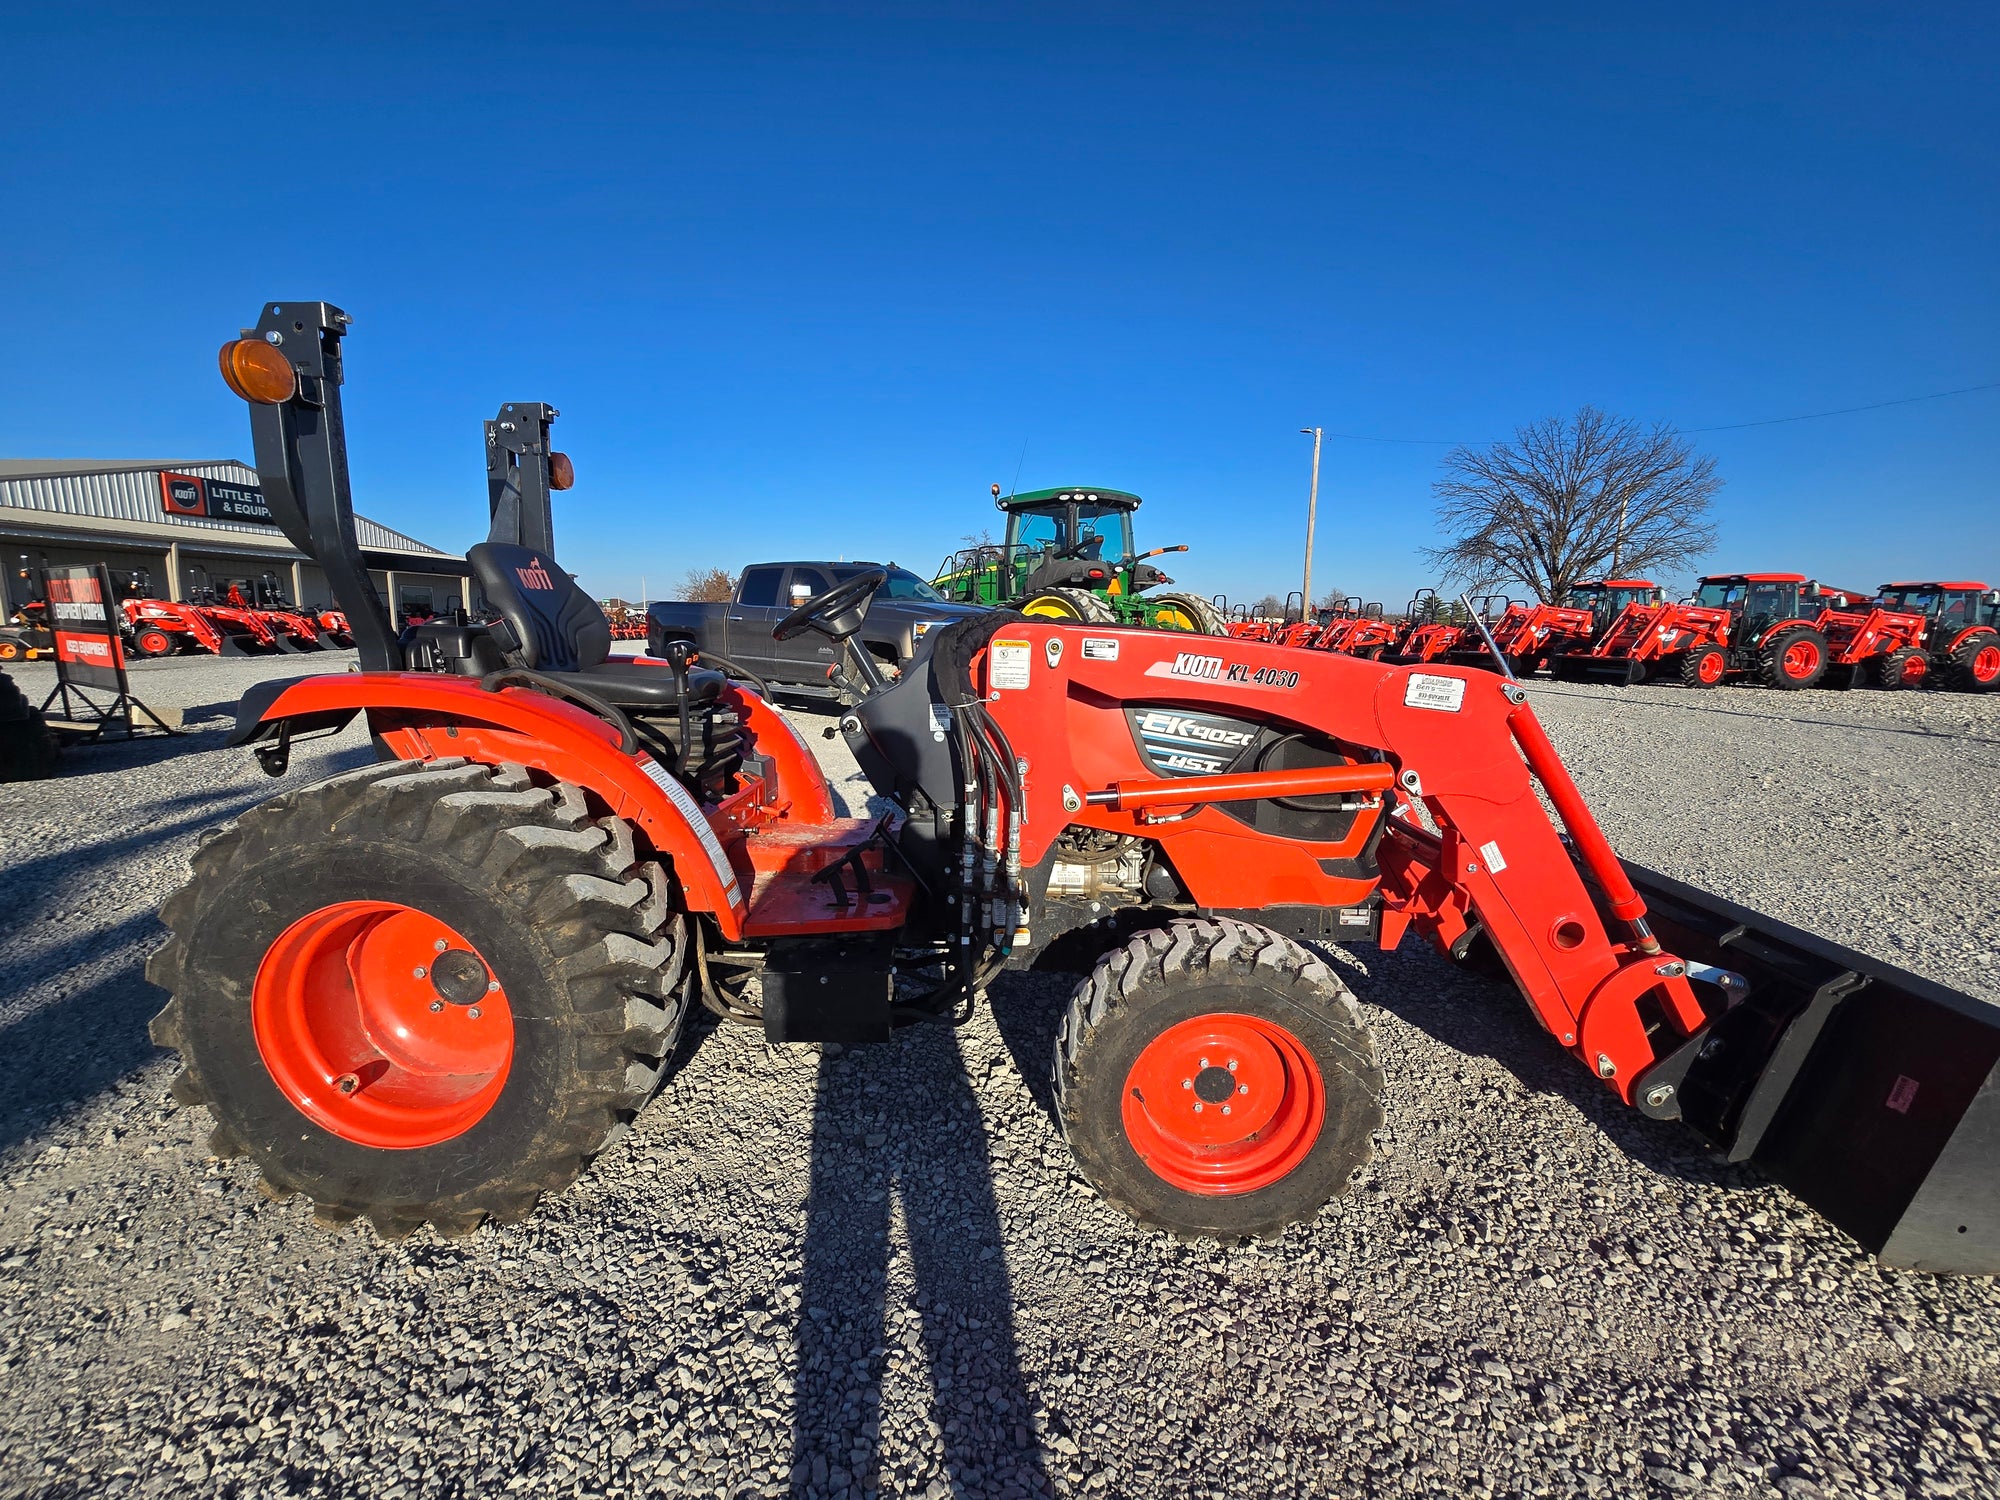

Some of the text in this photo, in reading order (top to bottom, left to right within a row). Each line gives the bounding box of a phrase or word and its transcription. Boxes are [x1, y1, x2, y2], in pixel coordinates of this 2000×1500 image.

[211, 487, 252, 503] LITTLE
[223, 502, 273, 518] & EQUIP
[515, 567, 554, 590] KIOTI
[1171, 652, 1300, 690] KIOTI KL 4030
